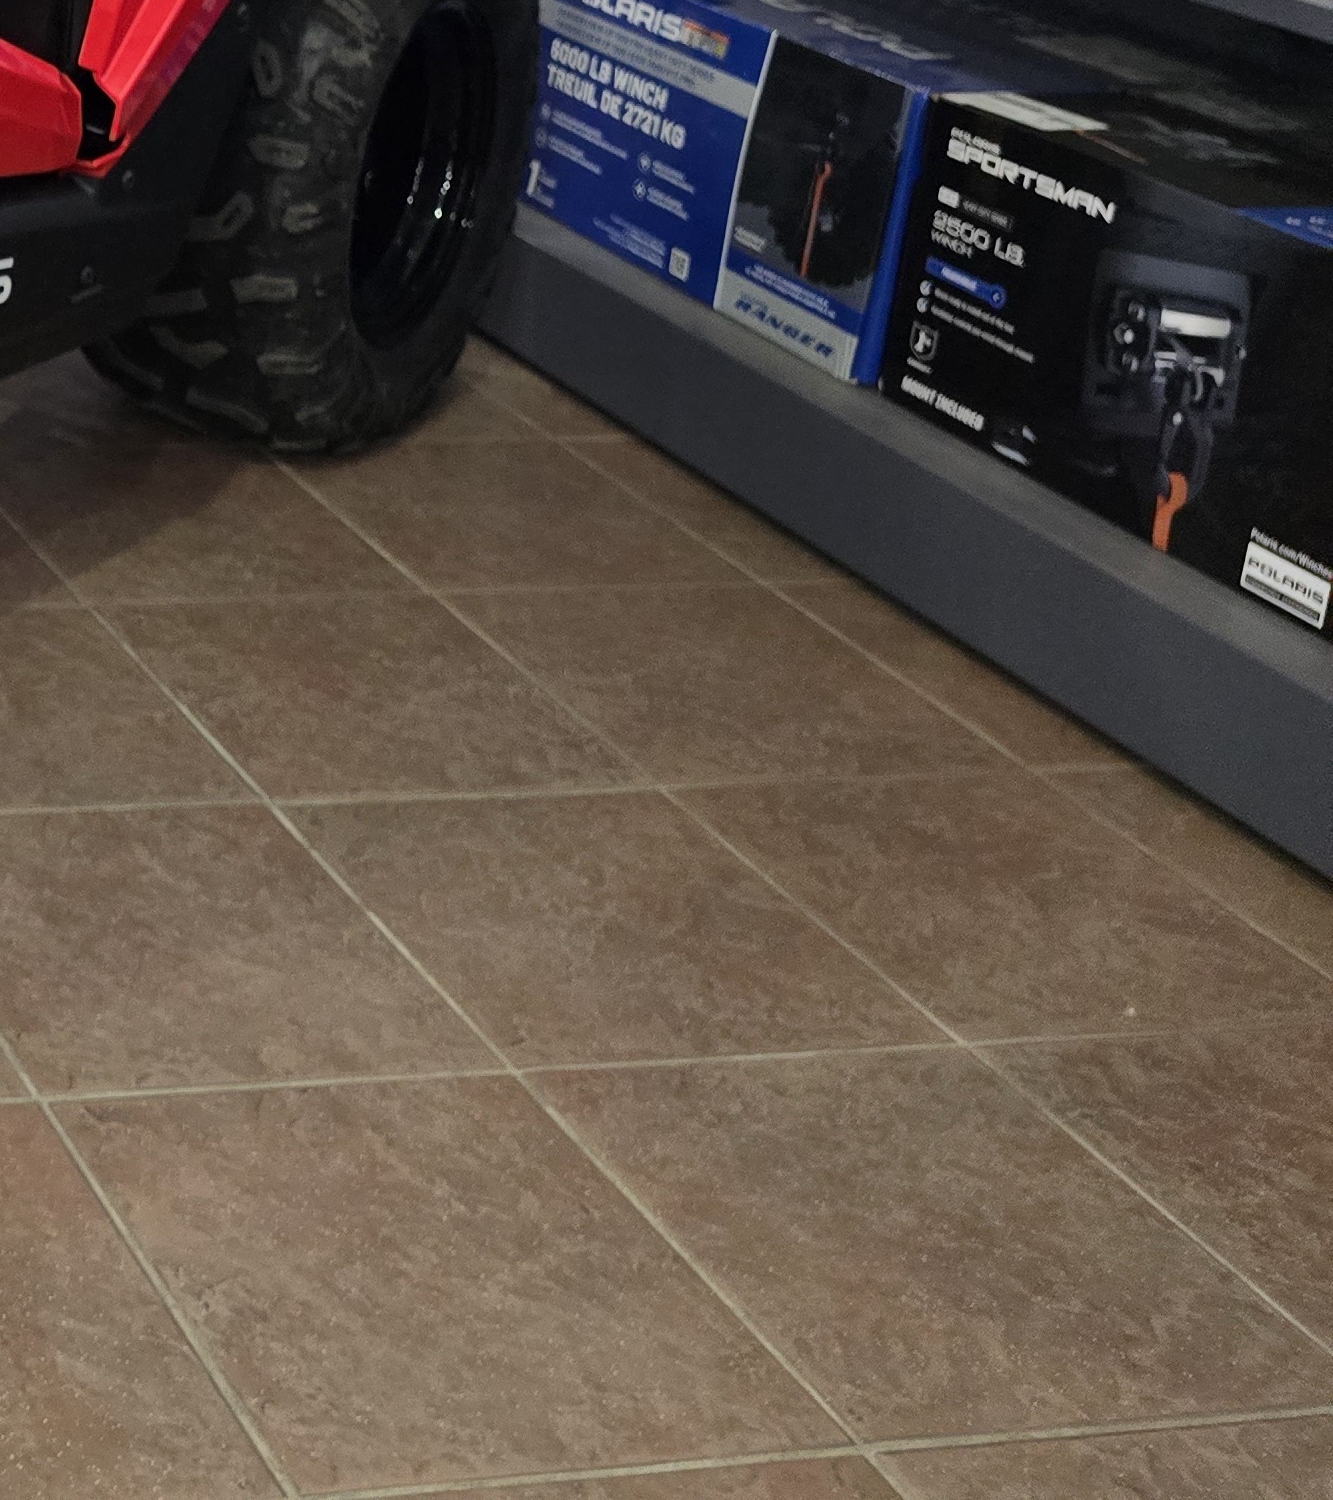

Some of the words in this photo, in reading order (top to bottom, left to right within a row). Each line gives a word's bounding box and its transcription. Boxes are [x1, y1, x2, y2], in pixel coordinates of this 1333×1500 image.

[547, 63, 599, 111] TREUIL
[599, 88, 624, 121] DE
[659, 118, 687, 151] KG
[588, 54, 613, 86] LB
[613, 63, 670, 113] WINCH
[945, 137, 1117, 225] SPORTSMAN
[1248, 555, 1324, 606] POLARIS
